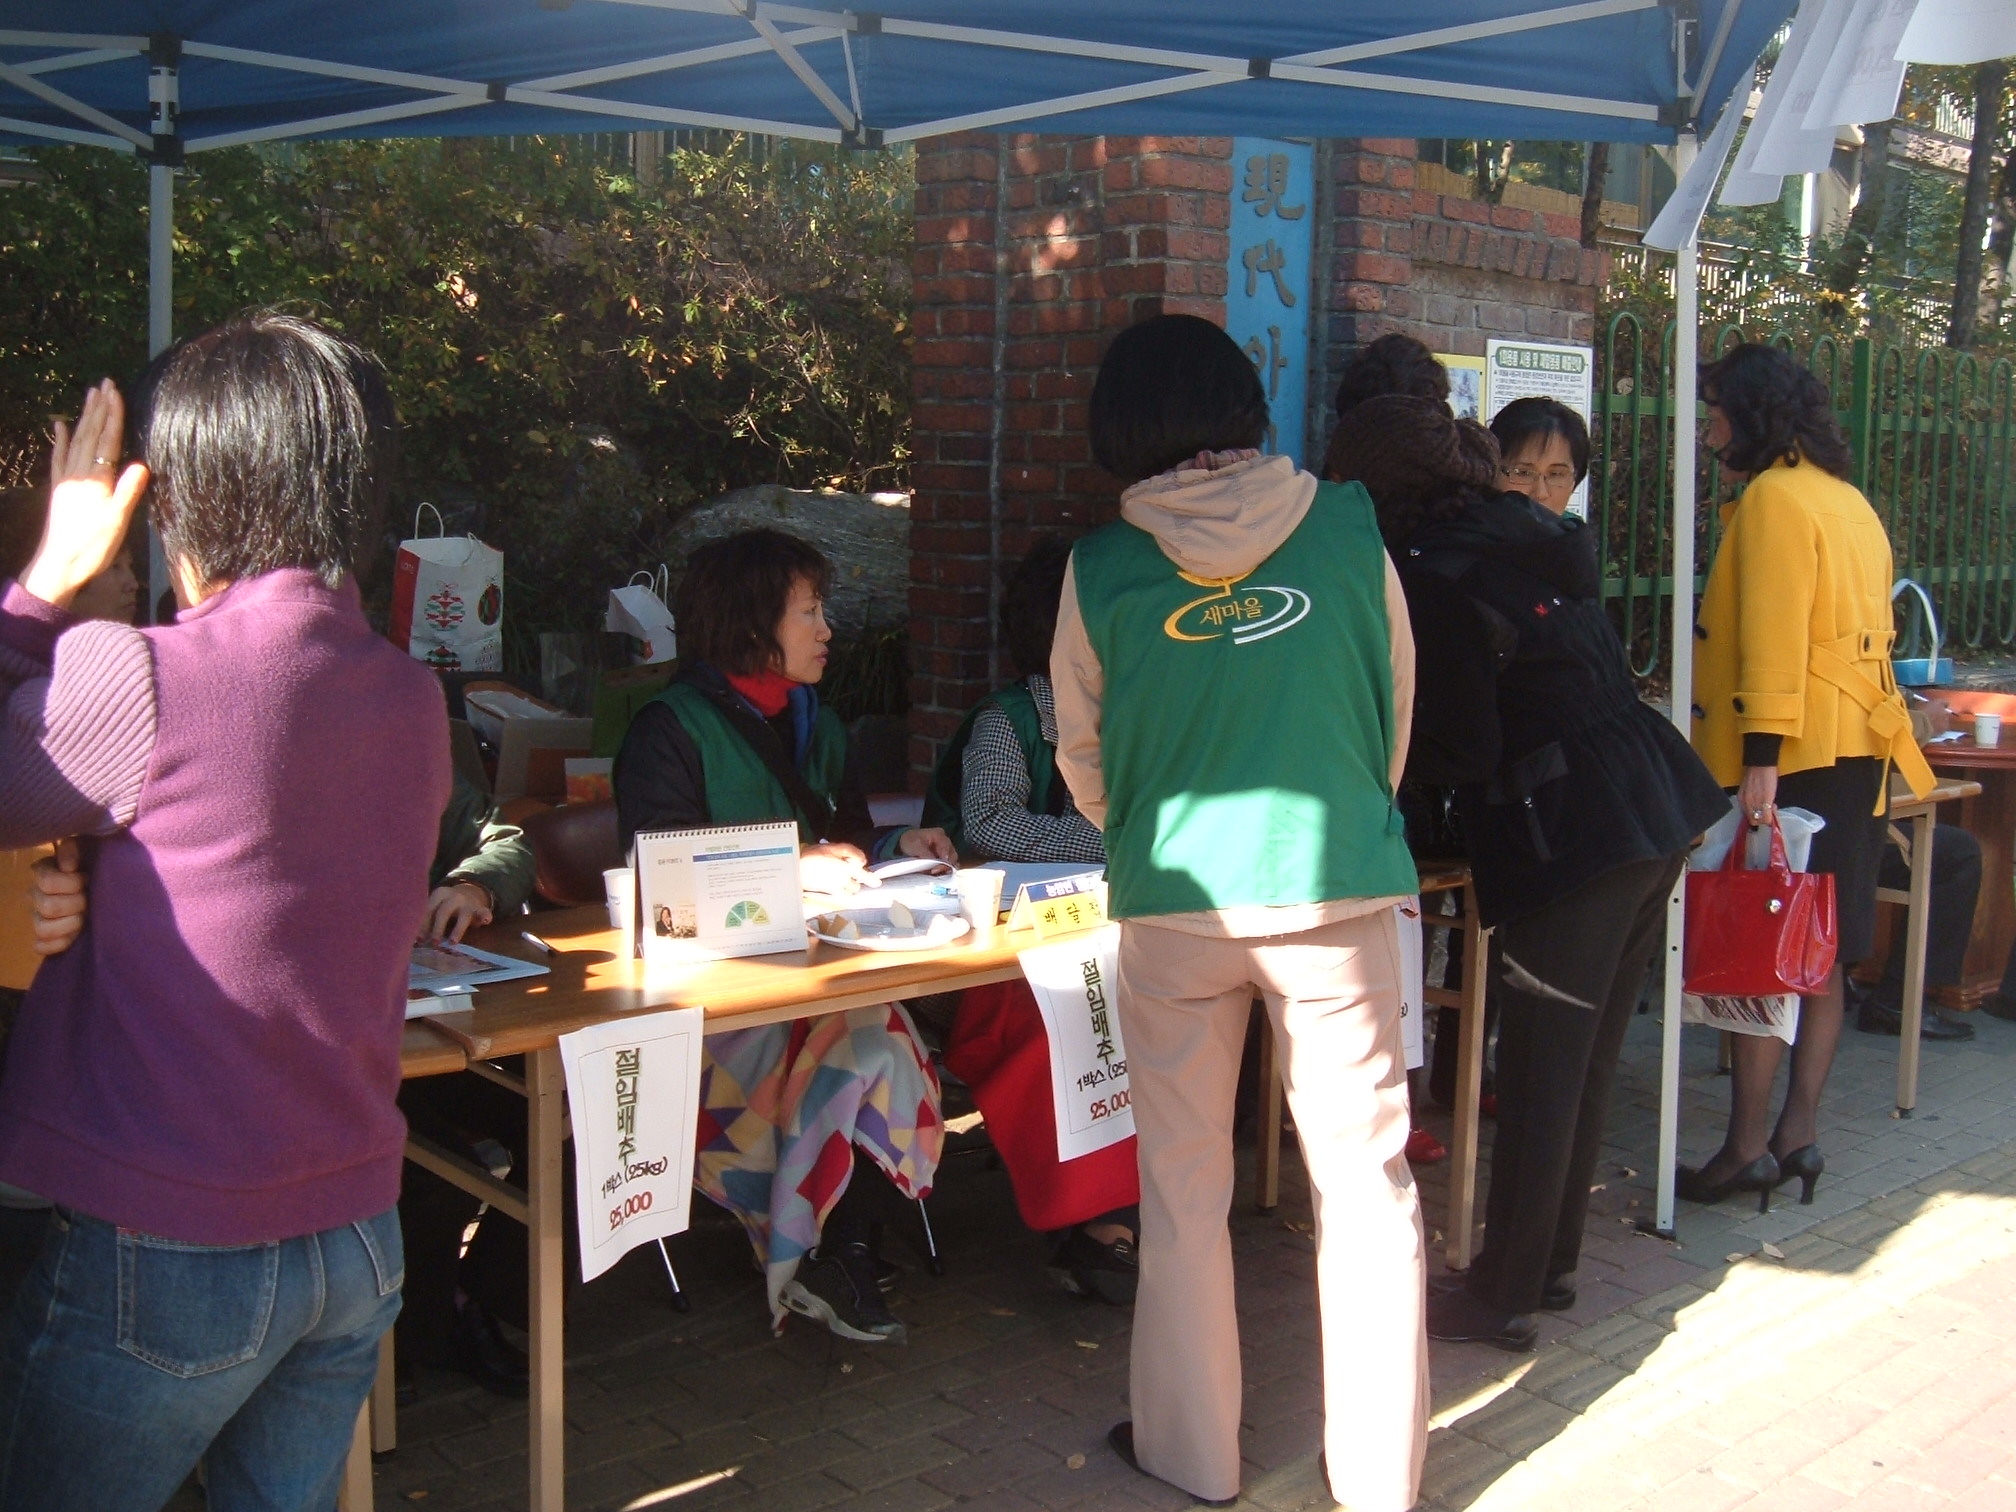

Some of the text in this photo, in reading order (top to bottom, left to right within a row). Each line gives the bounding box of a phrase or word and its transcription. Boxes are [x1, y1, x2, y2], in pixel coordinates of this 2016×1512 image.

[1199, 597, 1264, 626] 새마을
[1080, 957, 1115, 1065] 절임배추
[1077, 1060, 1128, 1092] 1박스 (25
[615, 1047, 641, 1166] 절임배추
[601, 1156, 669, 1199] 1박스 (25kg)
[609, 1191, 653, 1231] 25,000
